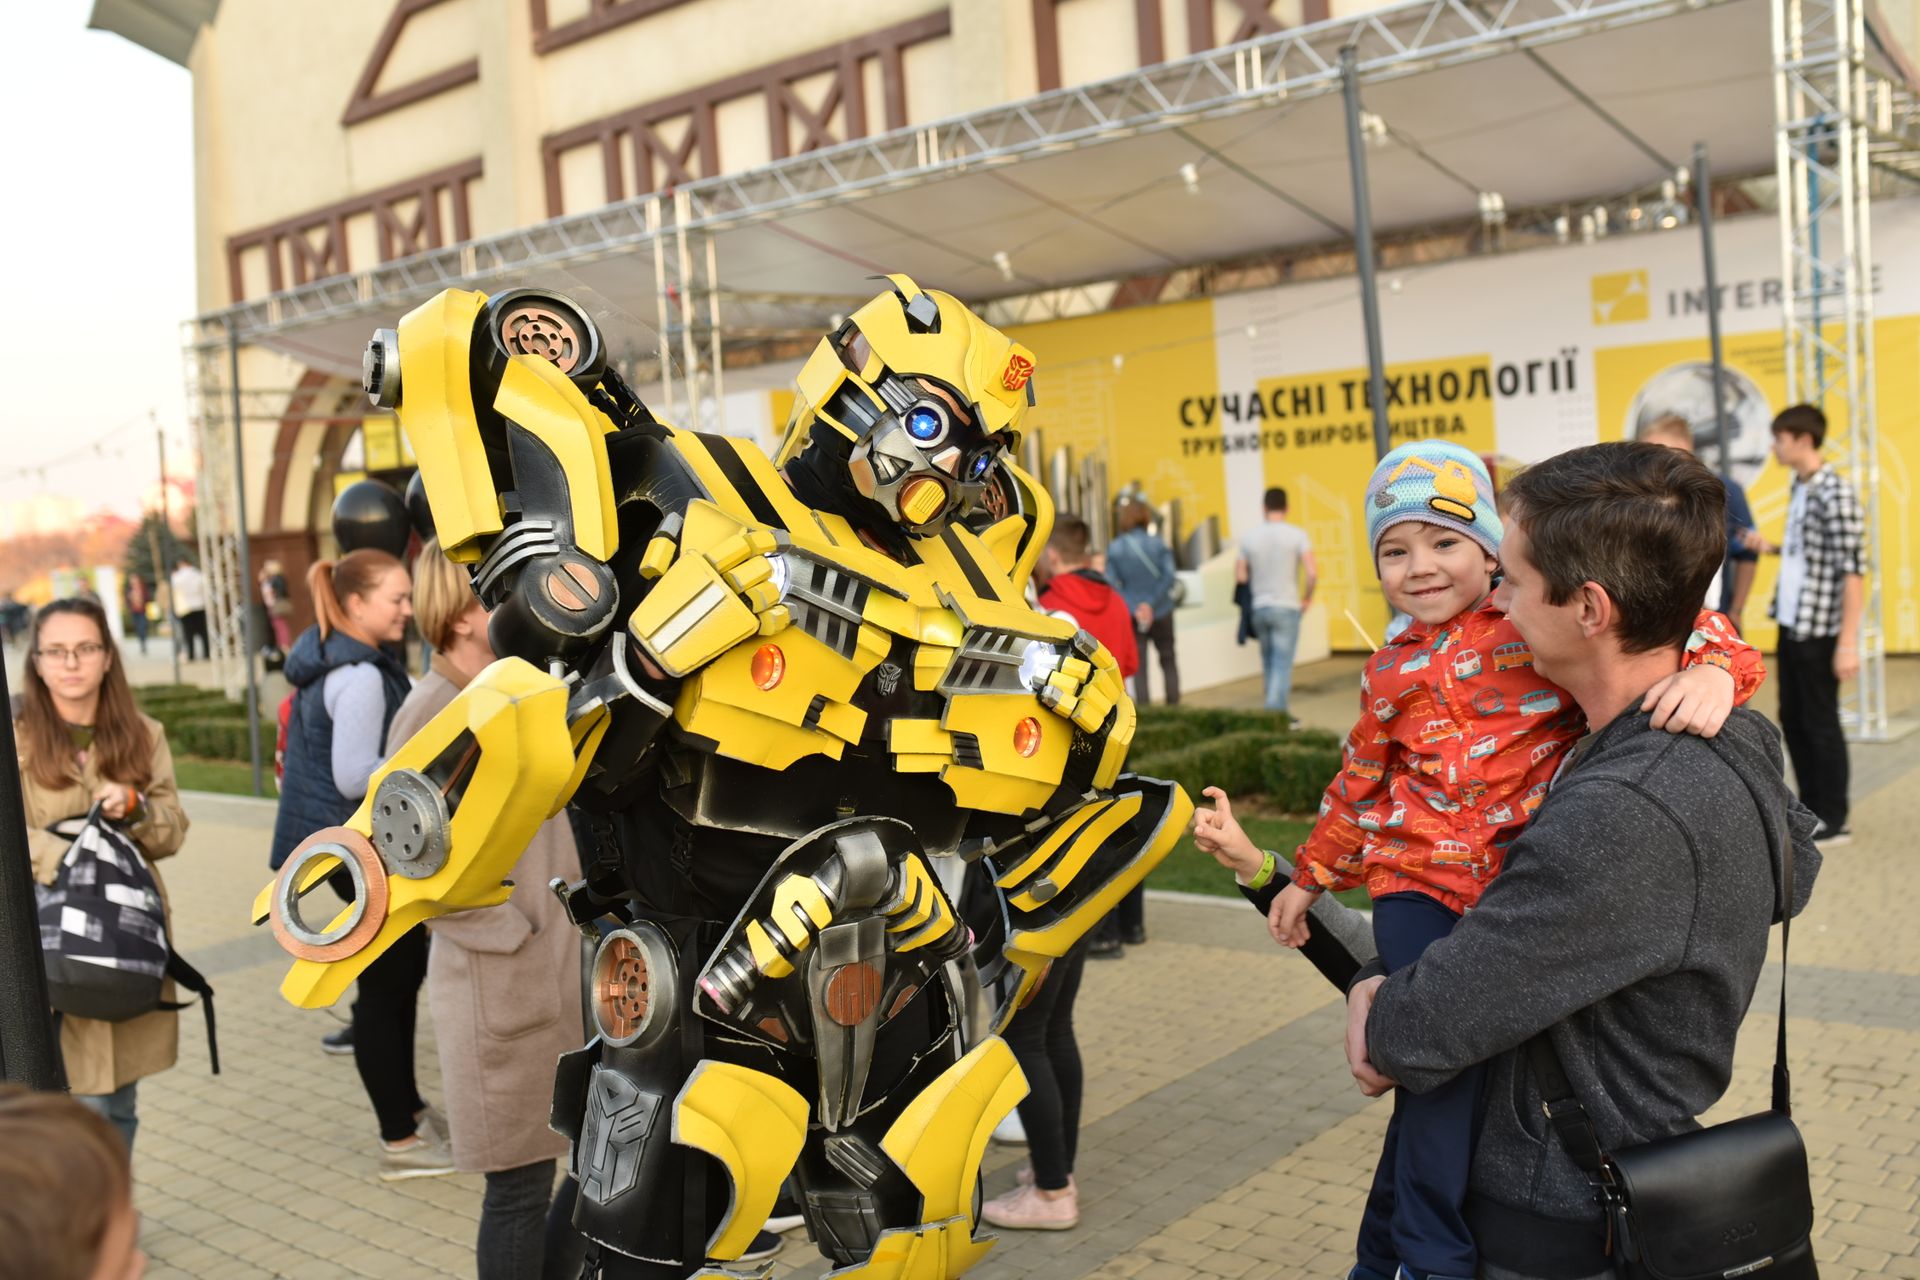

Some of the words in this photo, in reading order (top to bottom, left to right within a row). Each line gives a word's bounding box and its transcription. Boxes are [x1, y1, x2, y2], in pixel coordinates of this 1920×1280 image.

[1179, 381, 1327, 428] СУЧАСНІ
[1181, 430, 1286, 456] ТРУБНОГО
[1295, 414, 1466, 447] ВИРОБИЦТВА
